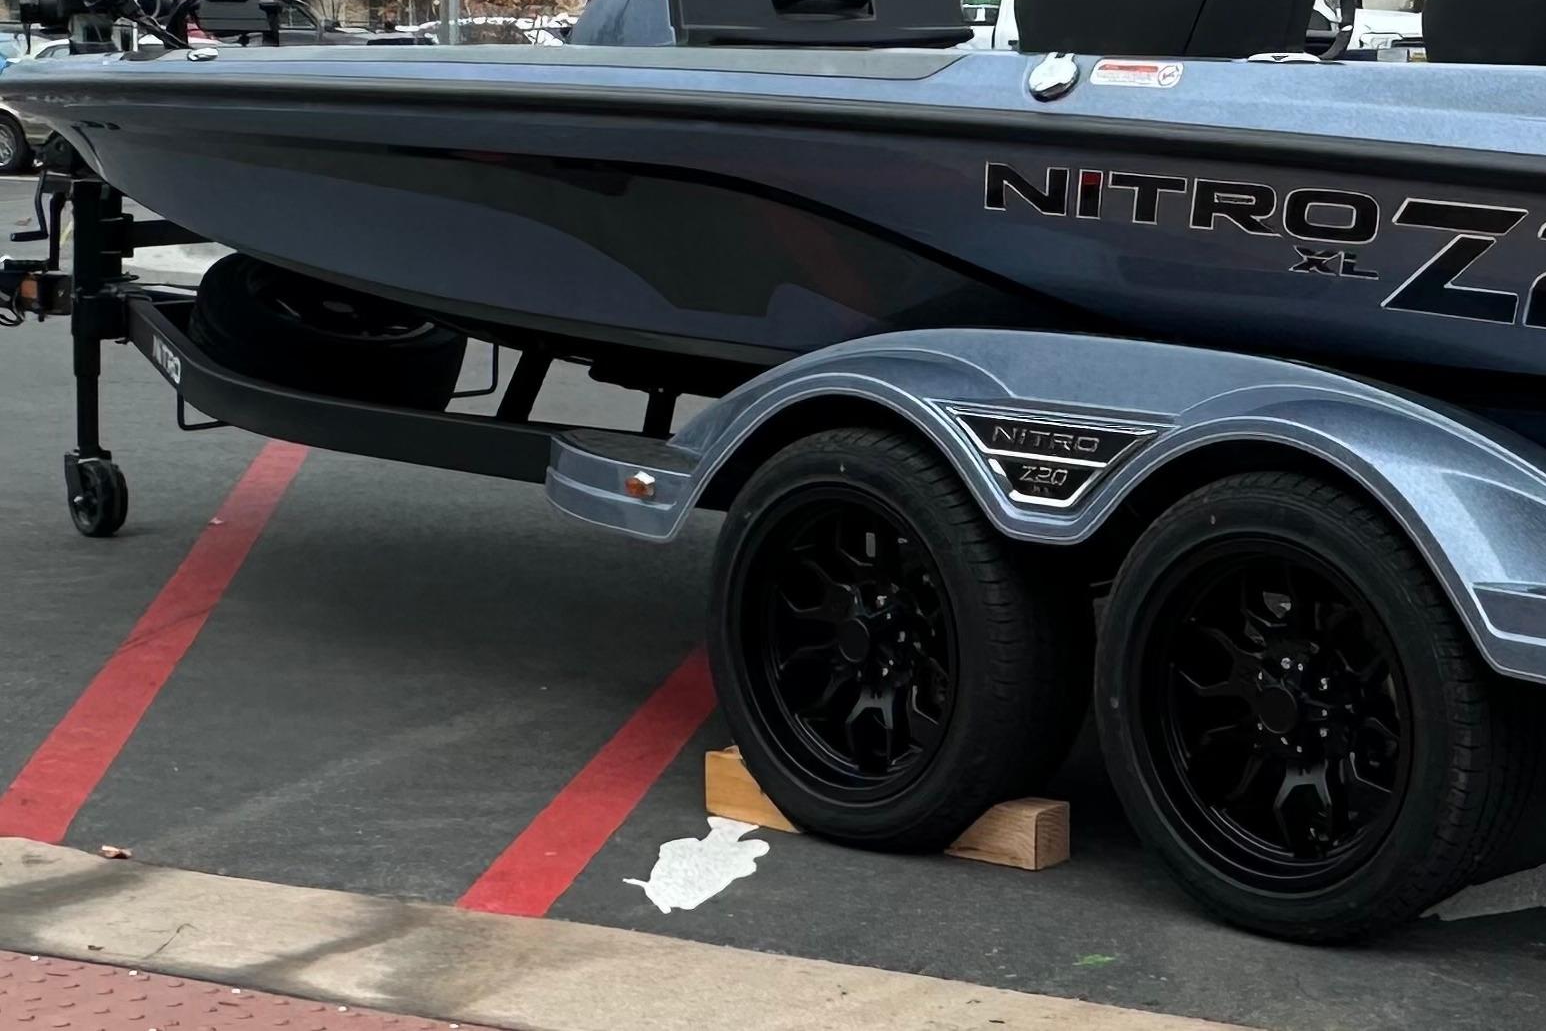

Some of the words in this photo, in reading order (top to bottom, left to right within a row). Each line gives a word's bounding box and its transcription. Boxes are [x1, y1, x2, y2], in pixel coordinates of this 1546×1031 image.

[984, 161, 1380, 244] NITRO
[1289, 246, 1379, 280] XL
[992, 425, 1100, 452] NITRO
[1019, 465, 1069, 486] Z20
